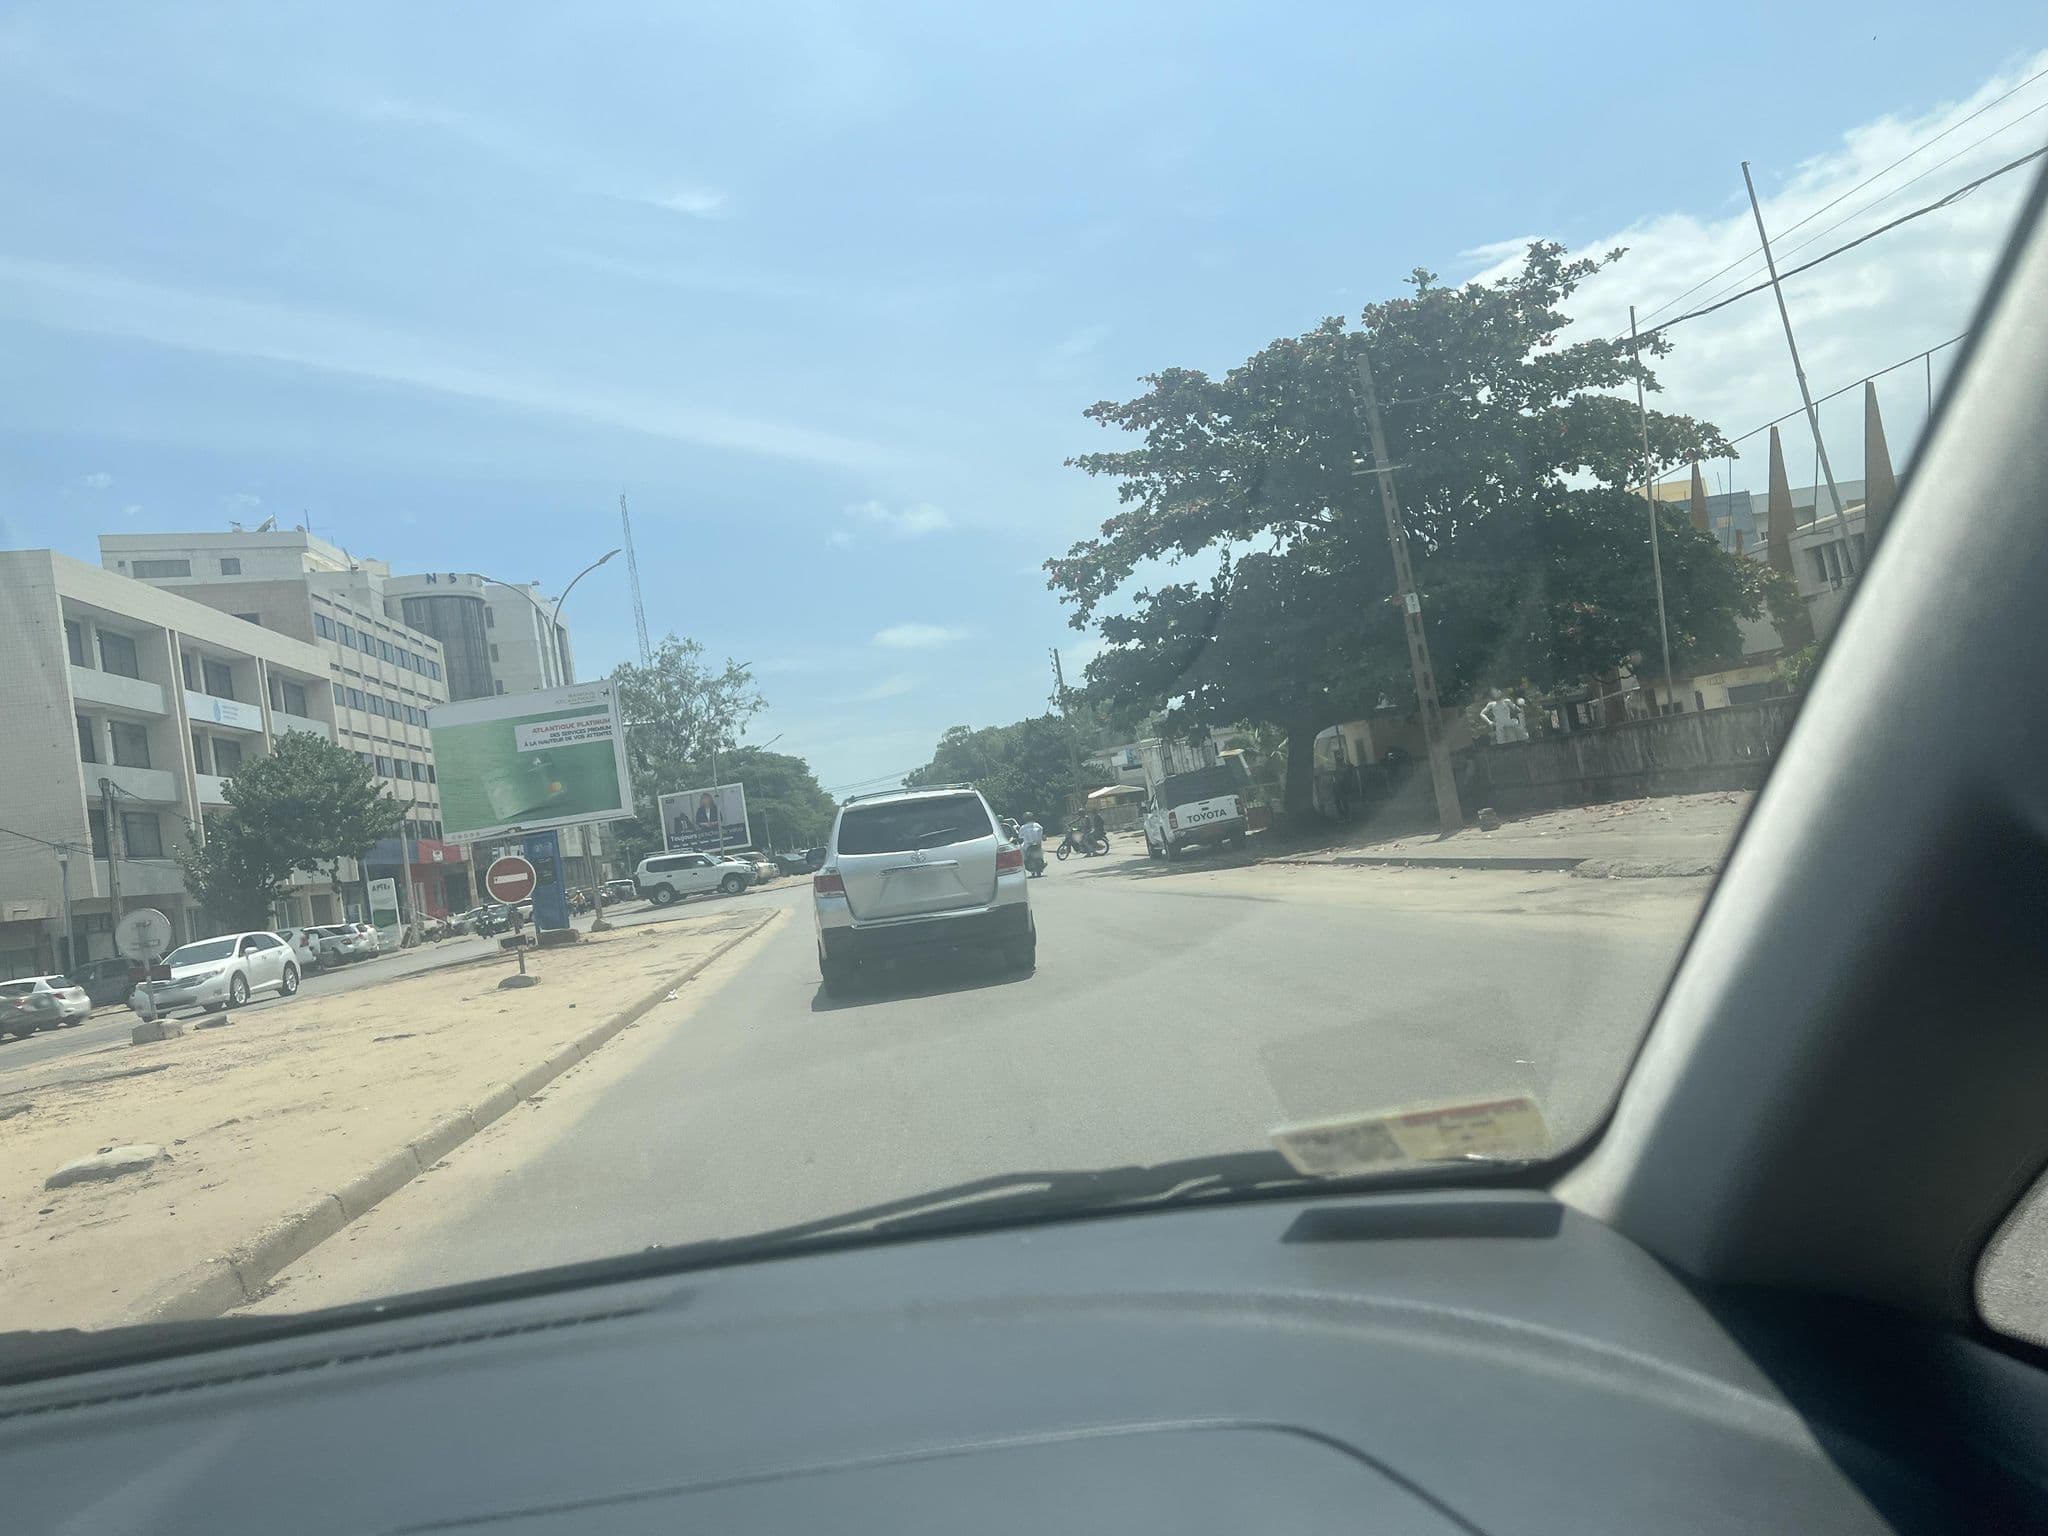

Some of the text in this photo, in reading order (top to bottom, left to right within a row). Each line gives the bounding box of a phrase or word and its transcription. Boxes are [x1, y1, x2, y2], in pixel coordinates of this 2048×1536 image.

[532, 718, 611, 734] ATLANTIQUE PLATINUM
[587, 725, 612, 733] PREMIUM
[538, 737, 564, 745] HAUTEUR
[1187, 808, 1227, 824] TOYOTA
